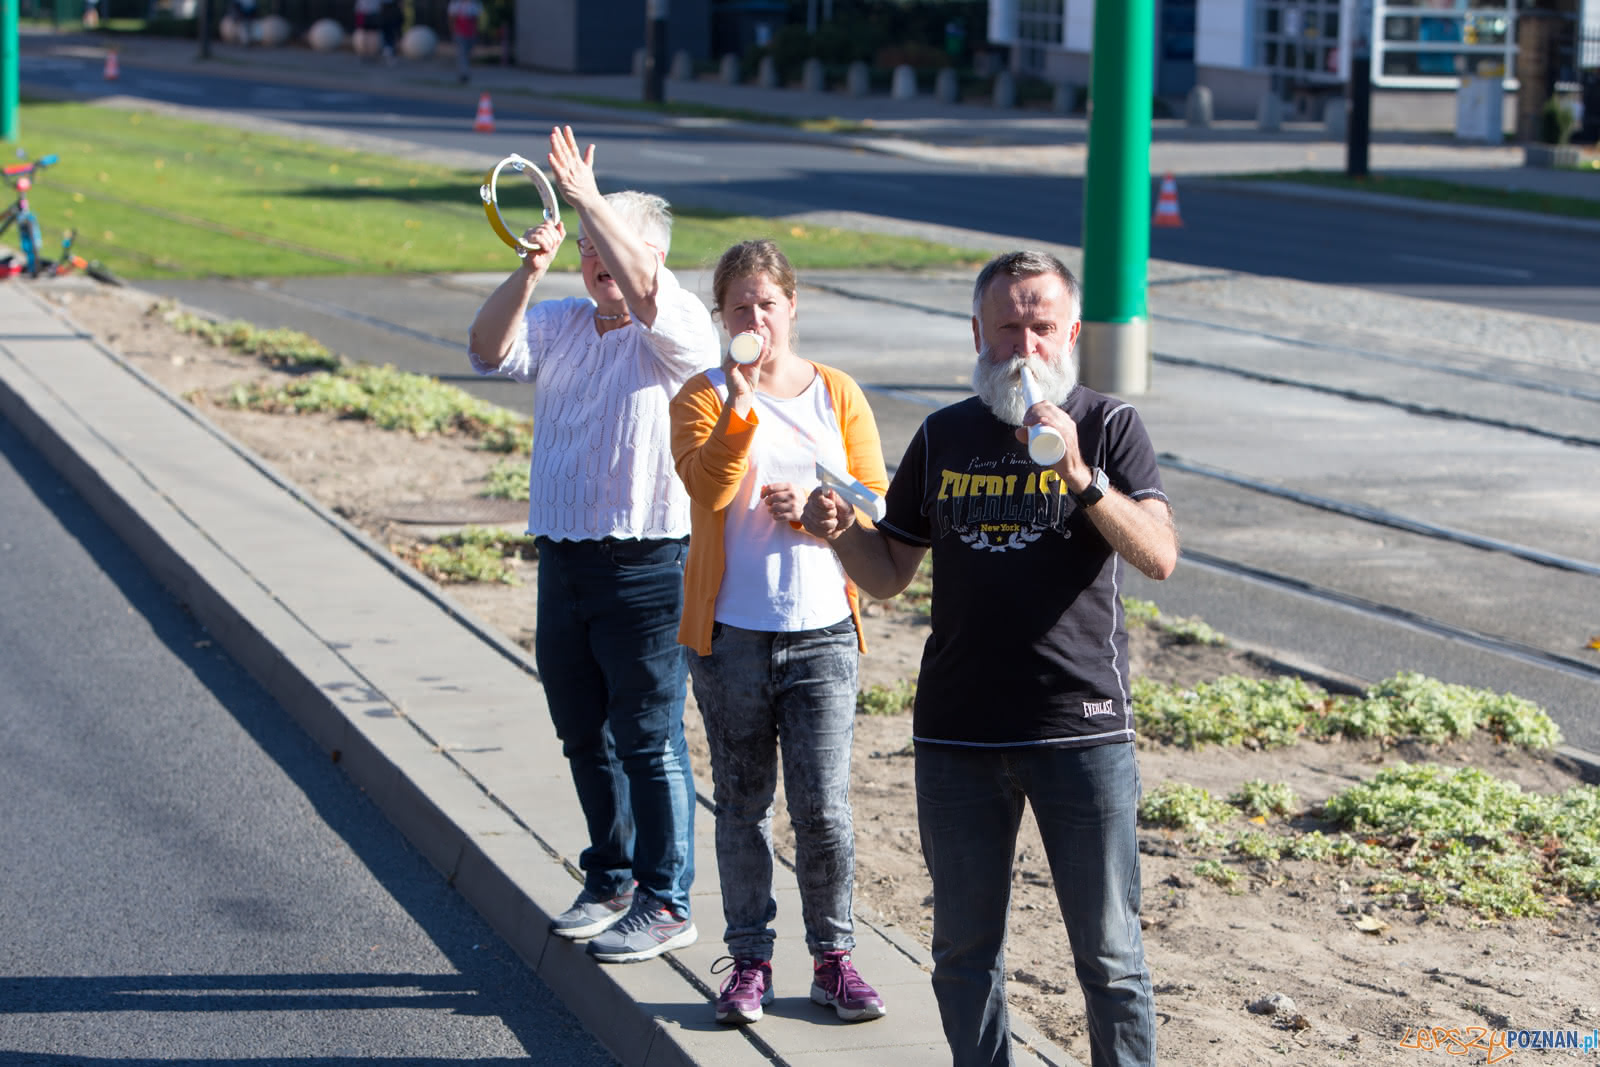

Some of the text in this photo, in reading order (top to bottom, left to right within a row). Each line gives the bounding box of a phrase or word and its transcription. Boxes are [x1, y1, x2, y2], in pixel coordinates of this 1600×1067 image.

[980, 523, 1020, 532] New York
[1082, 699, 1113, 718] EVERLAST
